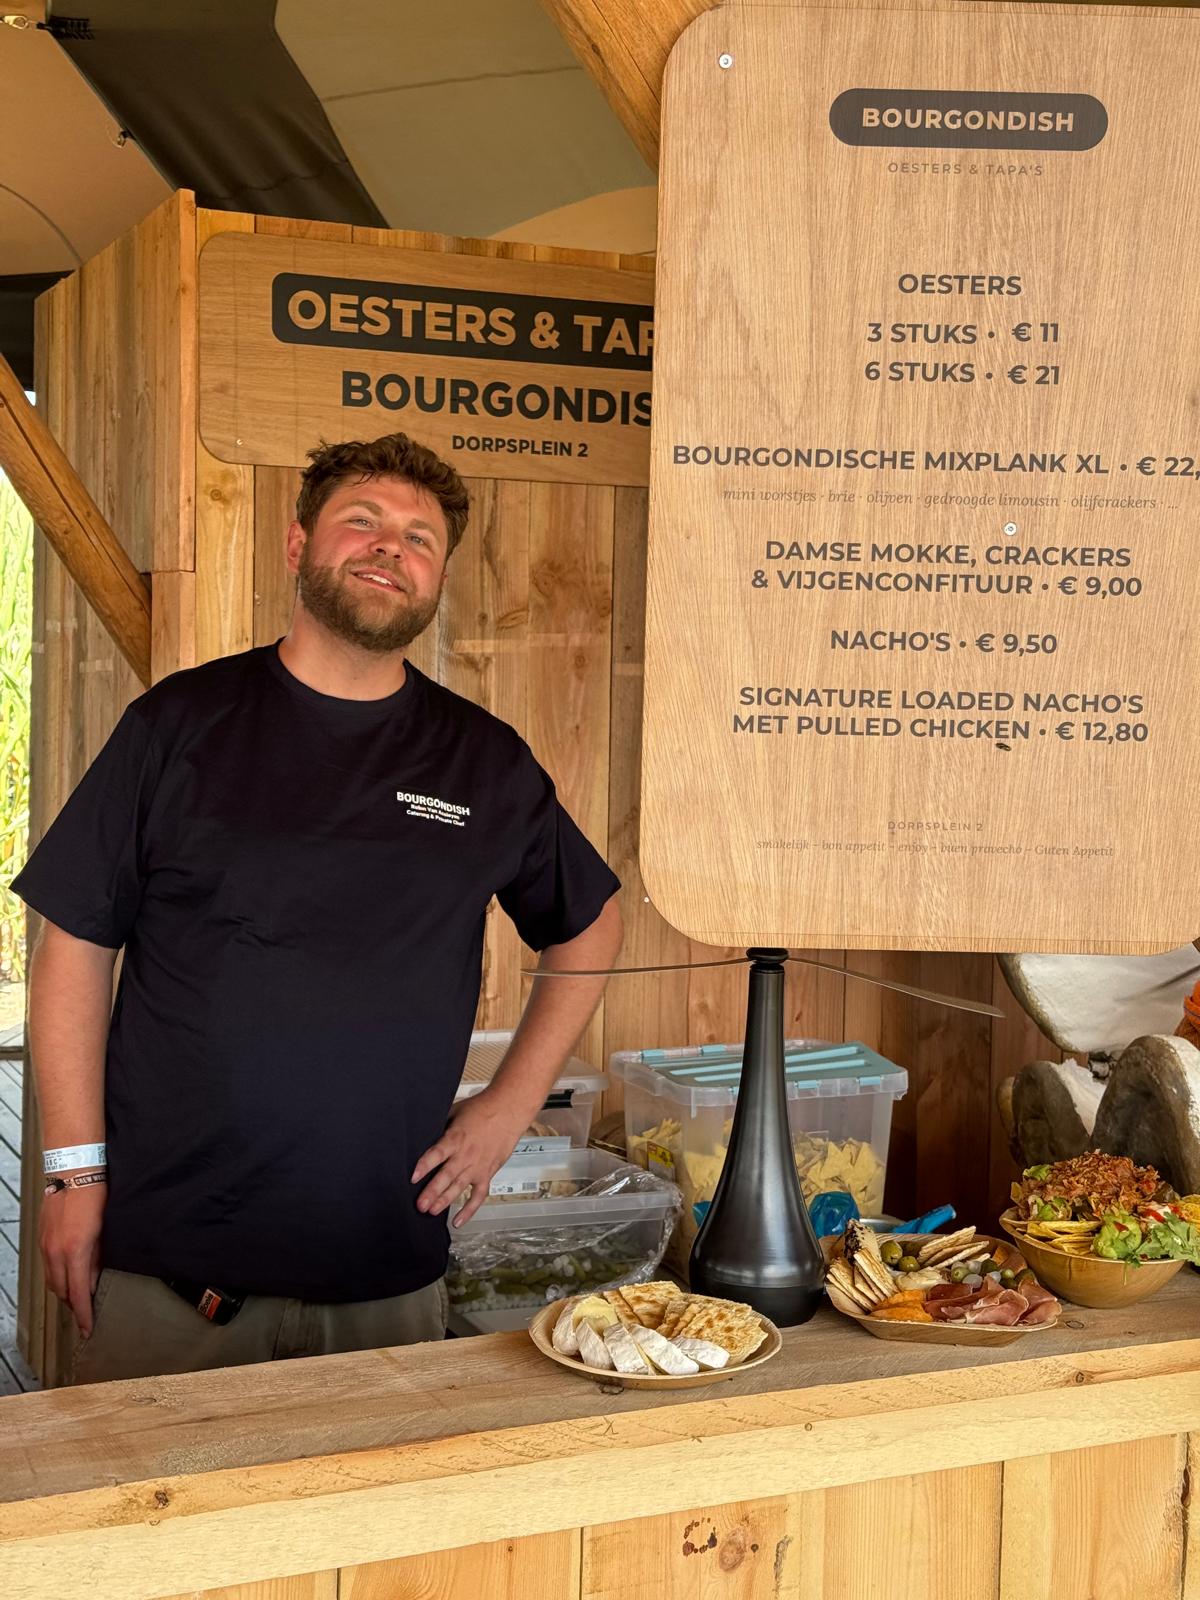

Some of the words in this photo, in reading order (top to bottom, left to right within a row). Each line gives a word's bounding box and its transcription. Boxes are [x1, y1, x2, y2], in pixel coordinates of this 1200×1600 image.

[863, 108, 1073, 131] BOURGONDISH
[888, 162, 962, 174] OESTERS
[969, 163, 978, 175] &
[986, 164, 1043, 176] TAPA'S
[898, 274, 1021, 295] OESTERS
[288, 290, 515, 345] OESTERS
[530, 312, 560, 349] &
[867, 323, 881, 342] 3
[891, 323, 977, 344] STUKS
[1012, 323, 1032, 342] €
[1040, 323, 1058, 342] 11
[865, 362, 880, 380] 6
[888, 362, 975, 382] STUKS
[1008, 365, 1027, 384] €
[1035, 366, 1059, 385] 21
[453, 436, 572, 456] DORPSPLEIN
[578, 443, 588, 457] 2
[674, 446, 915, 470] BOURGONDISCHE
[925, 452, 1067, 472] MIXPLANK
[1076, 454, 1109, 473] XL
[1136, 457, 1156, 475] €
[723, 488, 755, 502] mini
[759, 489, 817, 506] worstjes
[828, 489, 856, 503] brie
[867, 490, 913, 508] olijven
[924, 491, 995, 508] gedroogde
[998, 493, 1059, 507] limousin
[1071, 494, 1157, 512] olijfcrackers
[766, 541, 861, 561] DAMSE
[871, 544, 976, 568] MOKKE,
[986, 546, 1130, 567] CRACKERS
[752, 570, 768, 588] &
[777, 570, 1032, 594] VIJGENCONFITUUR
[1058, 576, 1077, 595] €
[1086, 577, 1142, 599] 9,00
[831, 630, 950, 651] NACHO'S
[976, 633, 995, 652] €
[1003, 634, 1057, 656] 9,50
[740, 687, 892, 708] SIGNATURE
[902, 691, 1014, 710] LOADED
[1024, 693, 1143, 713] NACHO'S
[734, 715, 789, 734] MET
[797, 716, 901, 736] PULLED
[910, 719, 1029, 739] CHICKEN
[1055, 722, 1075, 740] €
[1083, 722, 1148, 744] 12,80
[396, 791, 469, 815] BOURGONDISH
[888, 821, 971, 832] DORPSPLEIN
[976, 824, 984, 832] 2
[757, 839, 809, 853] smakelijk
[822, 841, 843, 851] bon
[845, 842, 886, 854] appetit
[898, 842, 928, 855] enjoy
[940, 843, 968, 853] buen
[1035, 845, 1069, 856] Guten
[1072, 846, 1114, 858] Appetit
